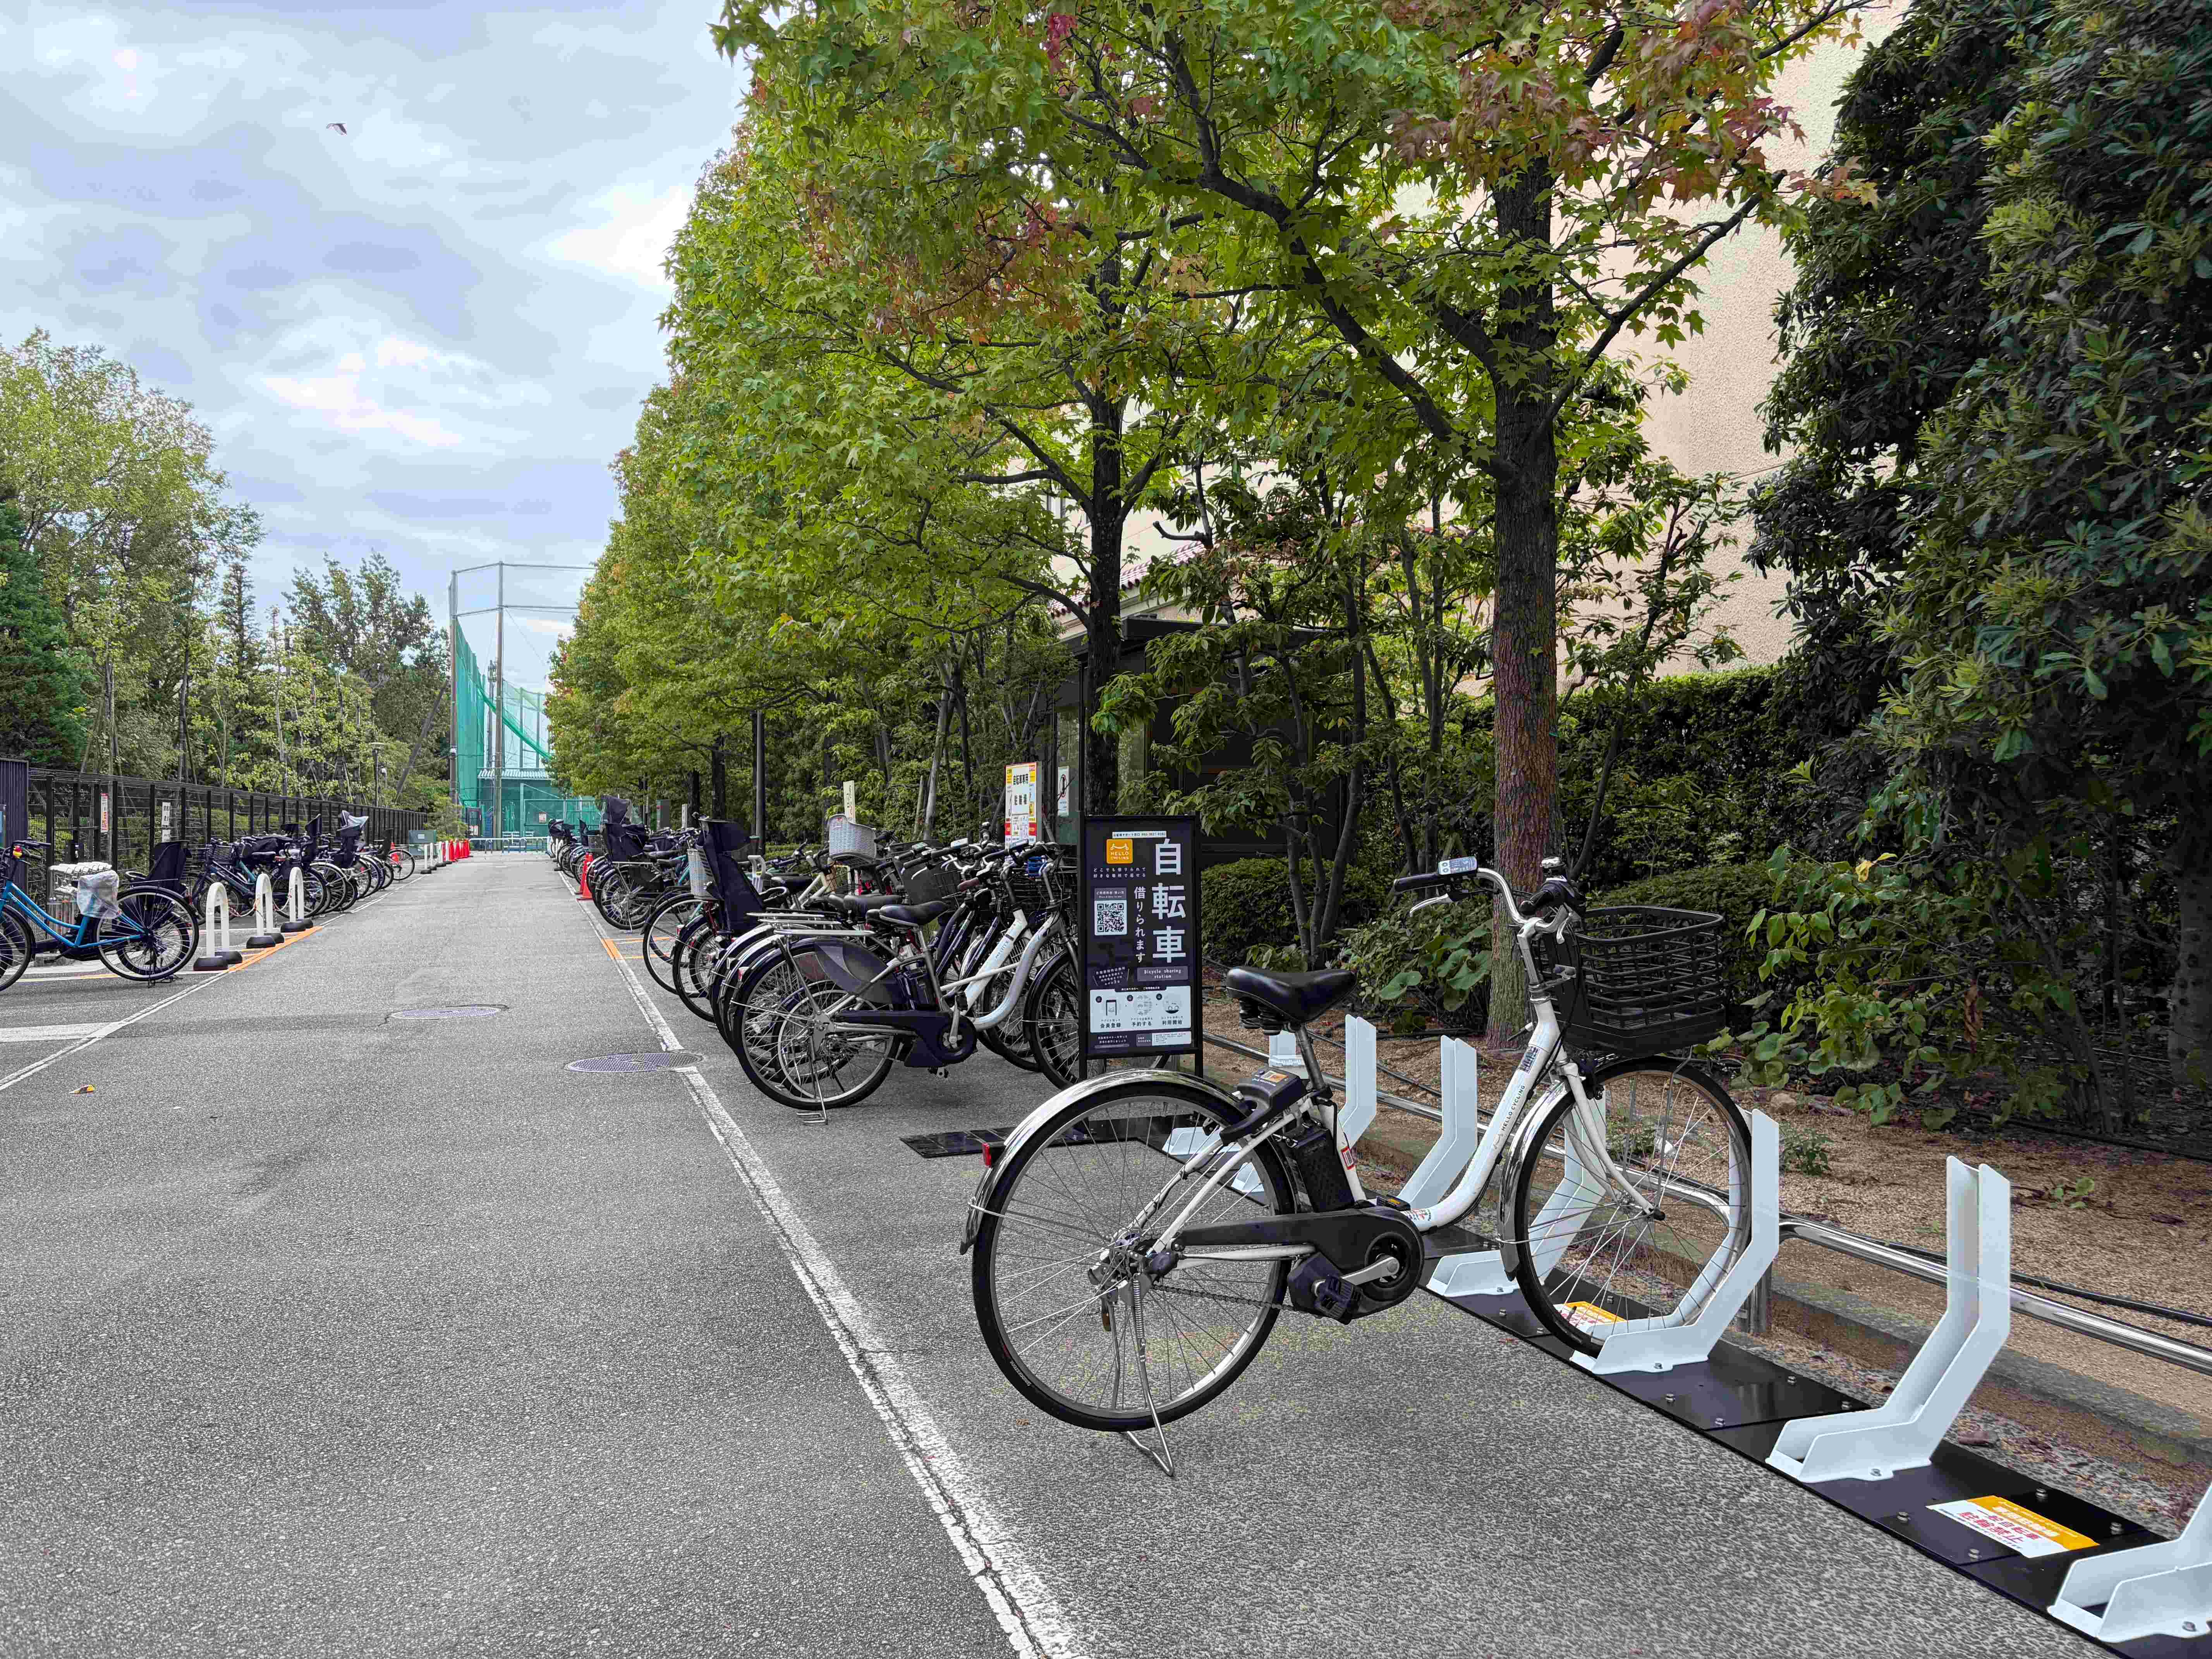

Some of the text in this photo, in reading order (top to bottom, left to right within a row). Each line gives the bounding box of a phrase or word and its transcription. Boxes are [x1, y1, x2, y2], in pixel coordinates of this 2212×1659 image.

[1134, 886, 1146, 963] 借りられます
[1152, 838, 1186, 963] 自転車
[1501, 1085, 1525, 1131] HELLO CYCLING
